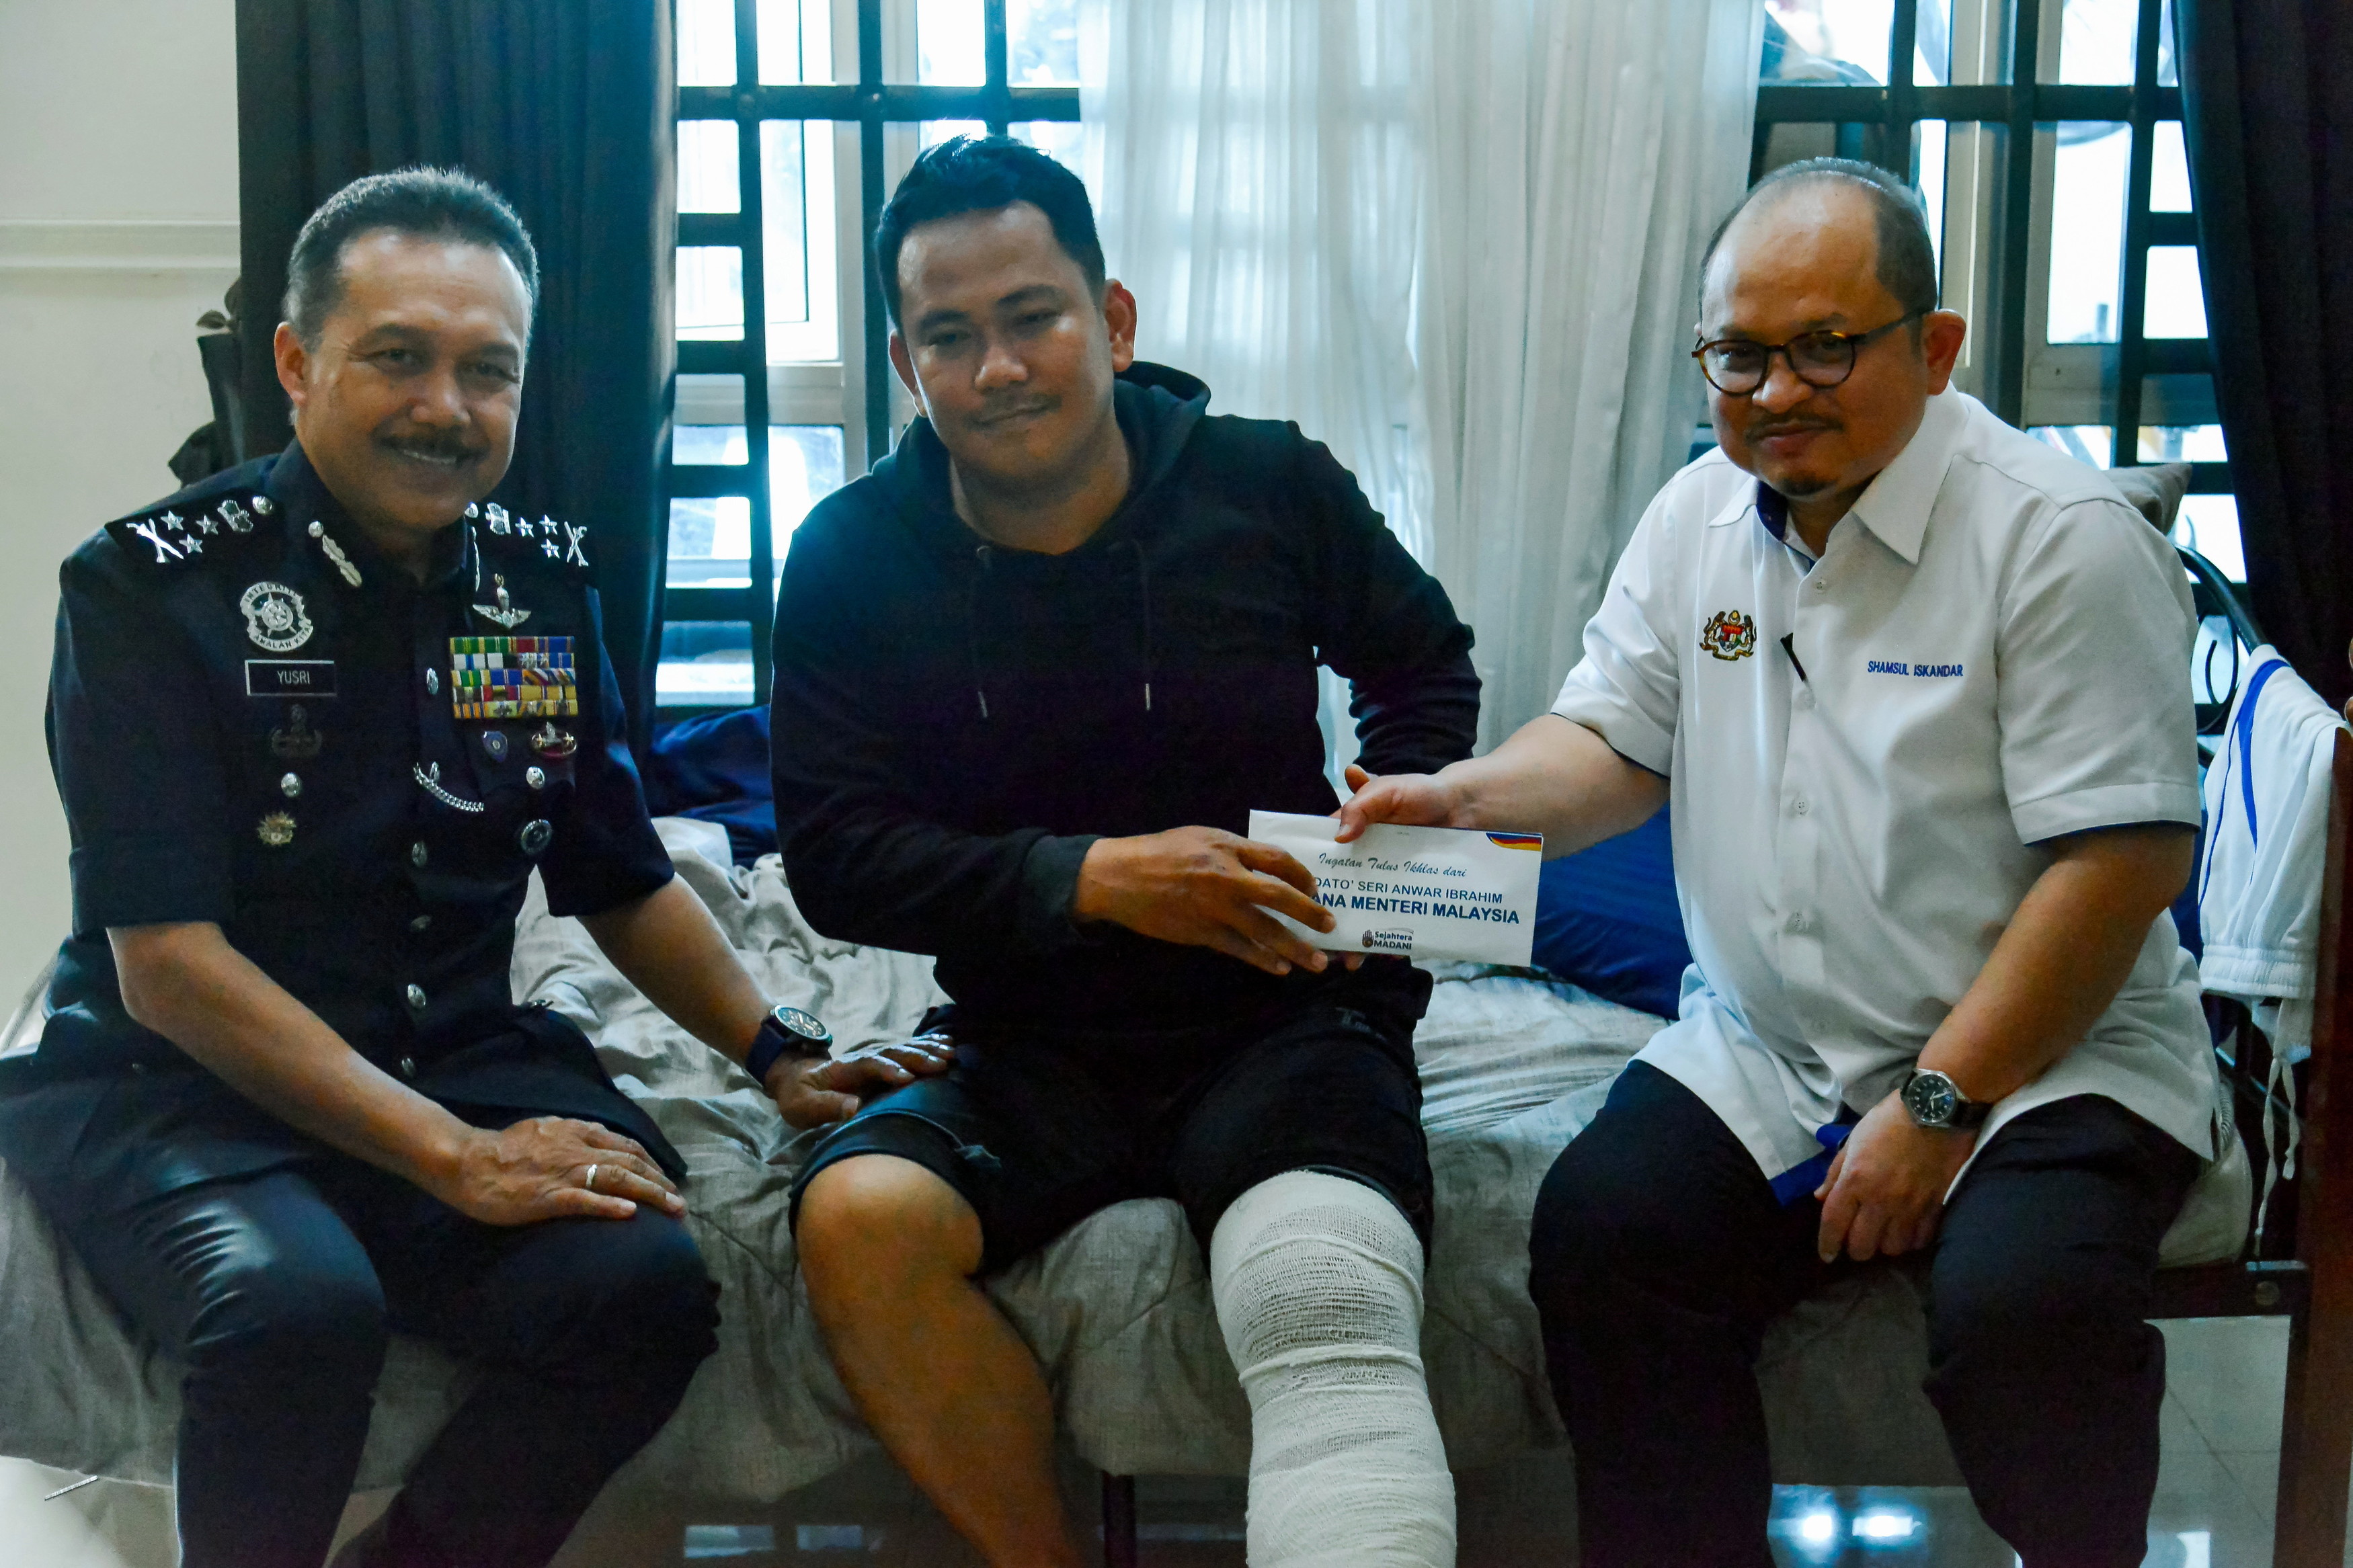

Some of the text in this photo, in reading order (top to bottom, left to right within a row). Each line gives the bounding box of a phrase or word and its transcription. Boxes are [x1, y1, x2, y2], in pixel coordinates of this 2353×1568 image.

[1868, 661, 1964, 677] SHAMSUL ISKANDAR
[277, 670, 311, 685] YUSRI
[1318, 852, 1468, 877] Ingatan Tulus Ikhlas dari
[1357, 880, 1388, 894] SERI
[1391, 884, 1442, 898] ANWAR
[1445, 889, 1503, 904] IBRAHIM
[1351, 895, 1428, 915] MENTERI
[1432, 903, 1520, 924] MALAYSIA
[1375, 931, 1412, 941] Sejahtera
[1373, 940, 1412, 950] MADANI
